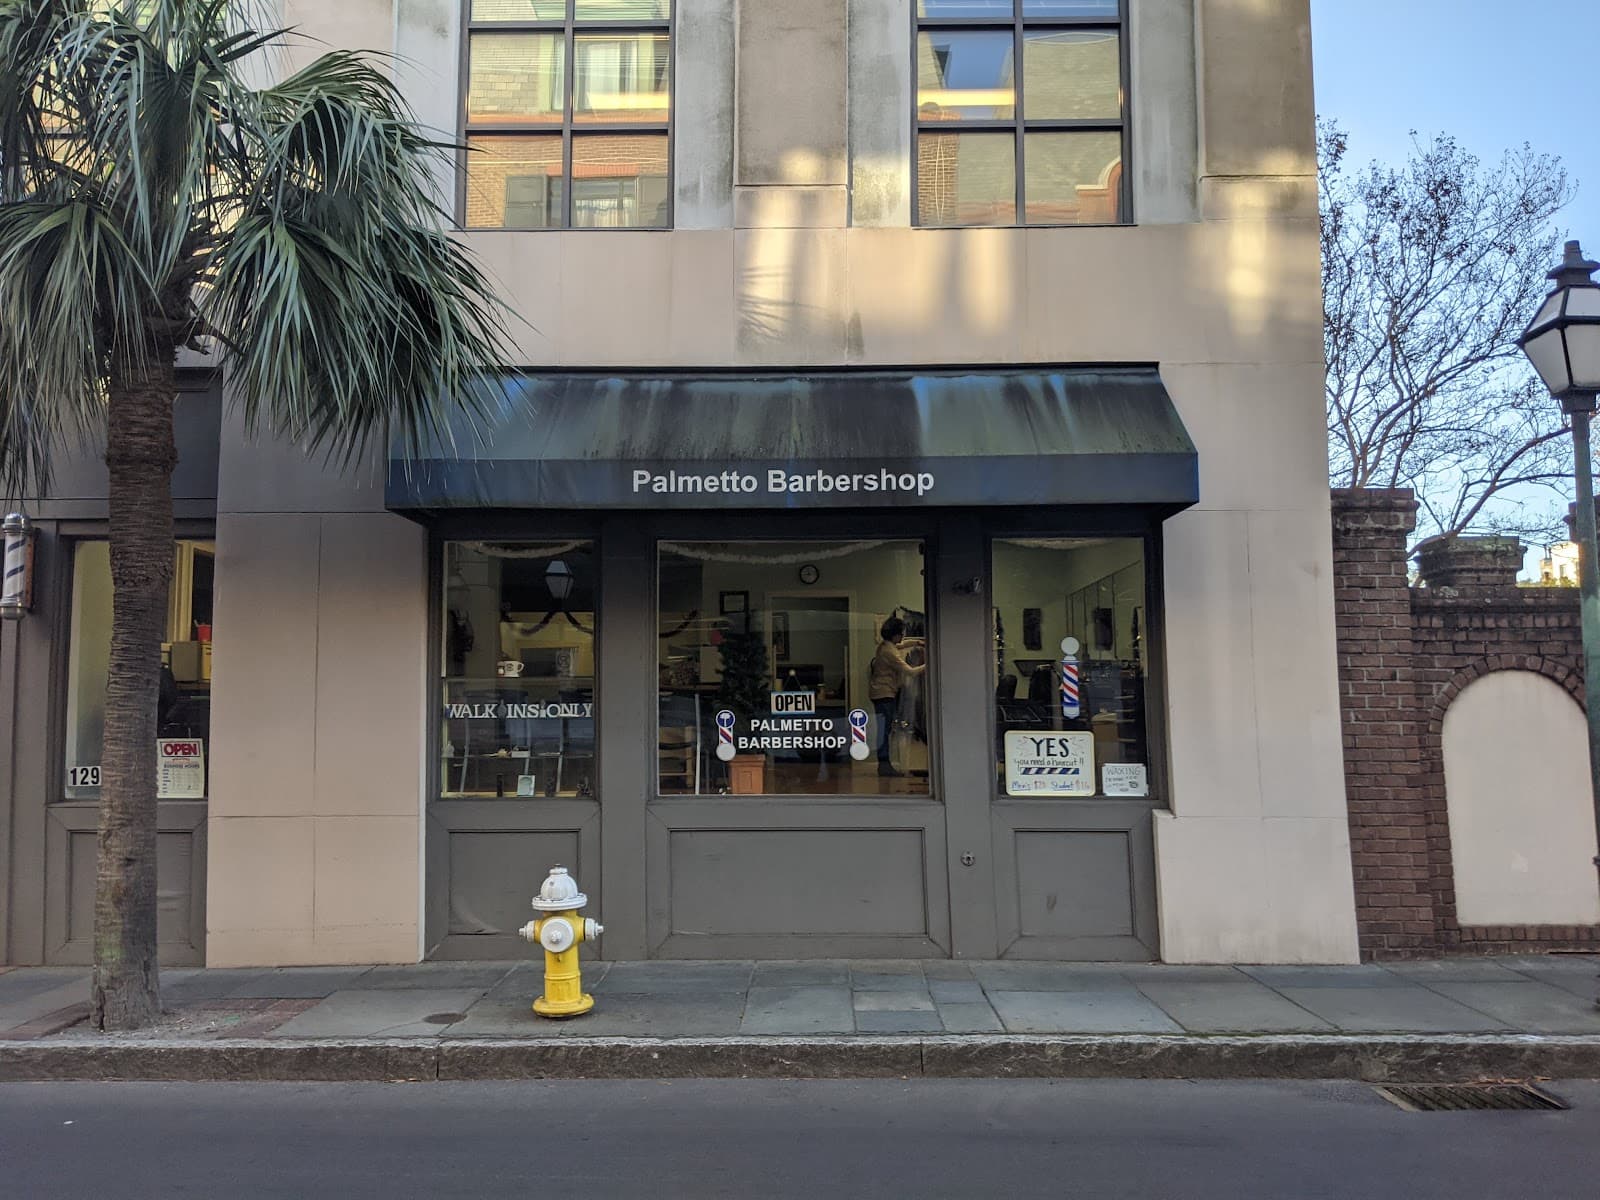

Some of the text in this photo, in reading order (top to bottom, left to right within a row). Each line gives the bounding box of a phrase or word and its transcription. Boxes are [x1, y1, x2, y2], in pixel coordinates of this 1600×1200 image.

[632, 468, 935, 496] Palmetto Barbershop
[446, 703, 593, 719] WALK INS ONLY
[774, 694, 813, 712] OPEN
[750, 718, 834, 732] PALMETTO
[164, 743, 198, 756] OPEN
[738, 735, 847, 750] BARBERSHOP
[1030, 737, 1070, 758] YES
[1014, 759, 1029, 771] you
[70, 767, 100, 786] 129
